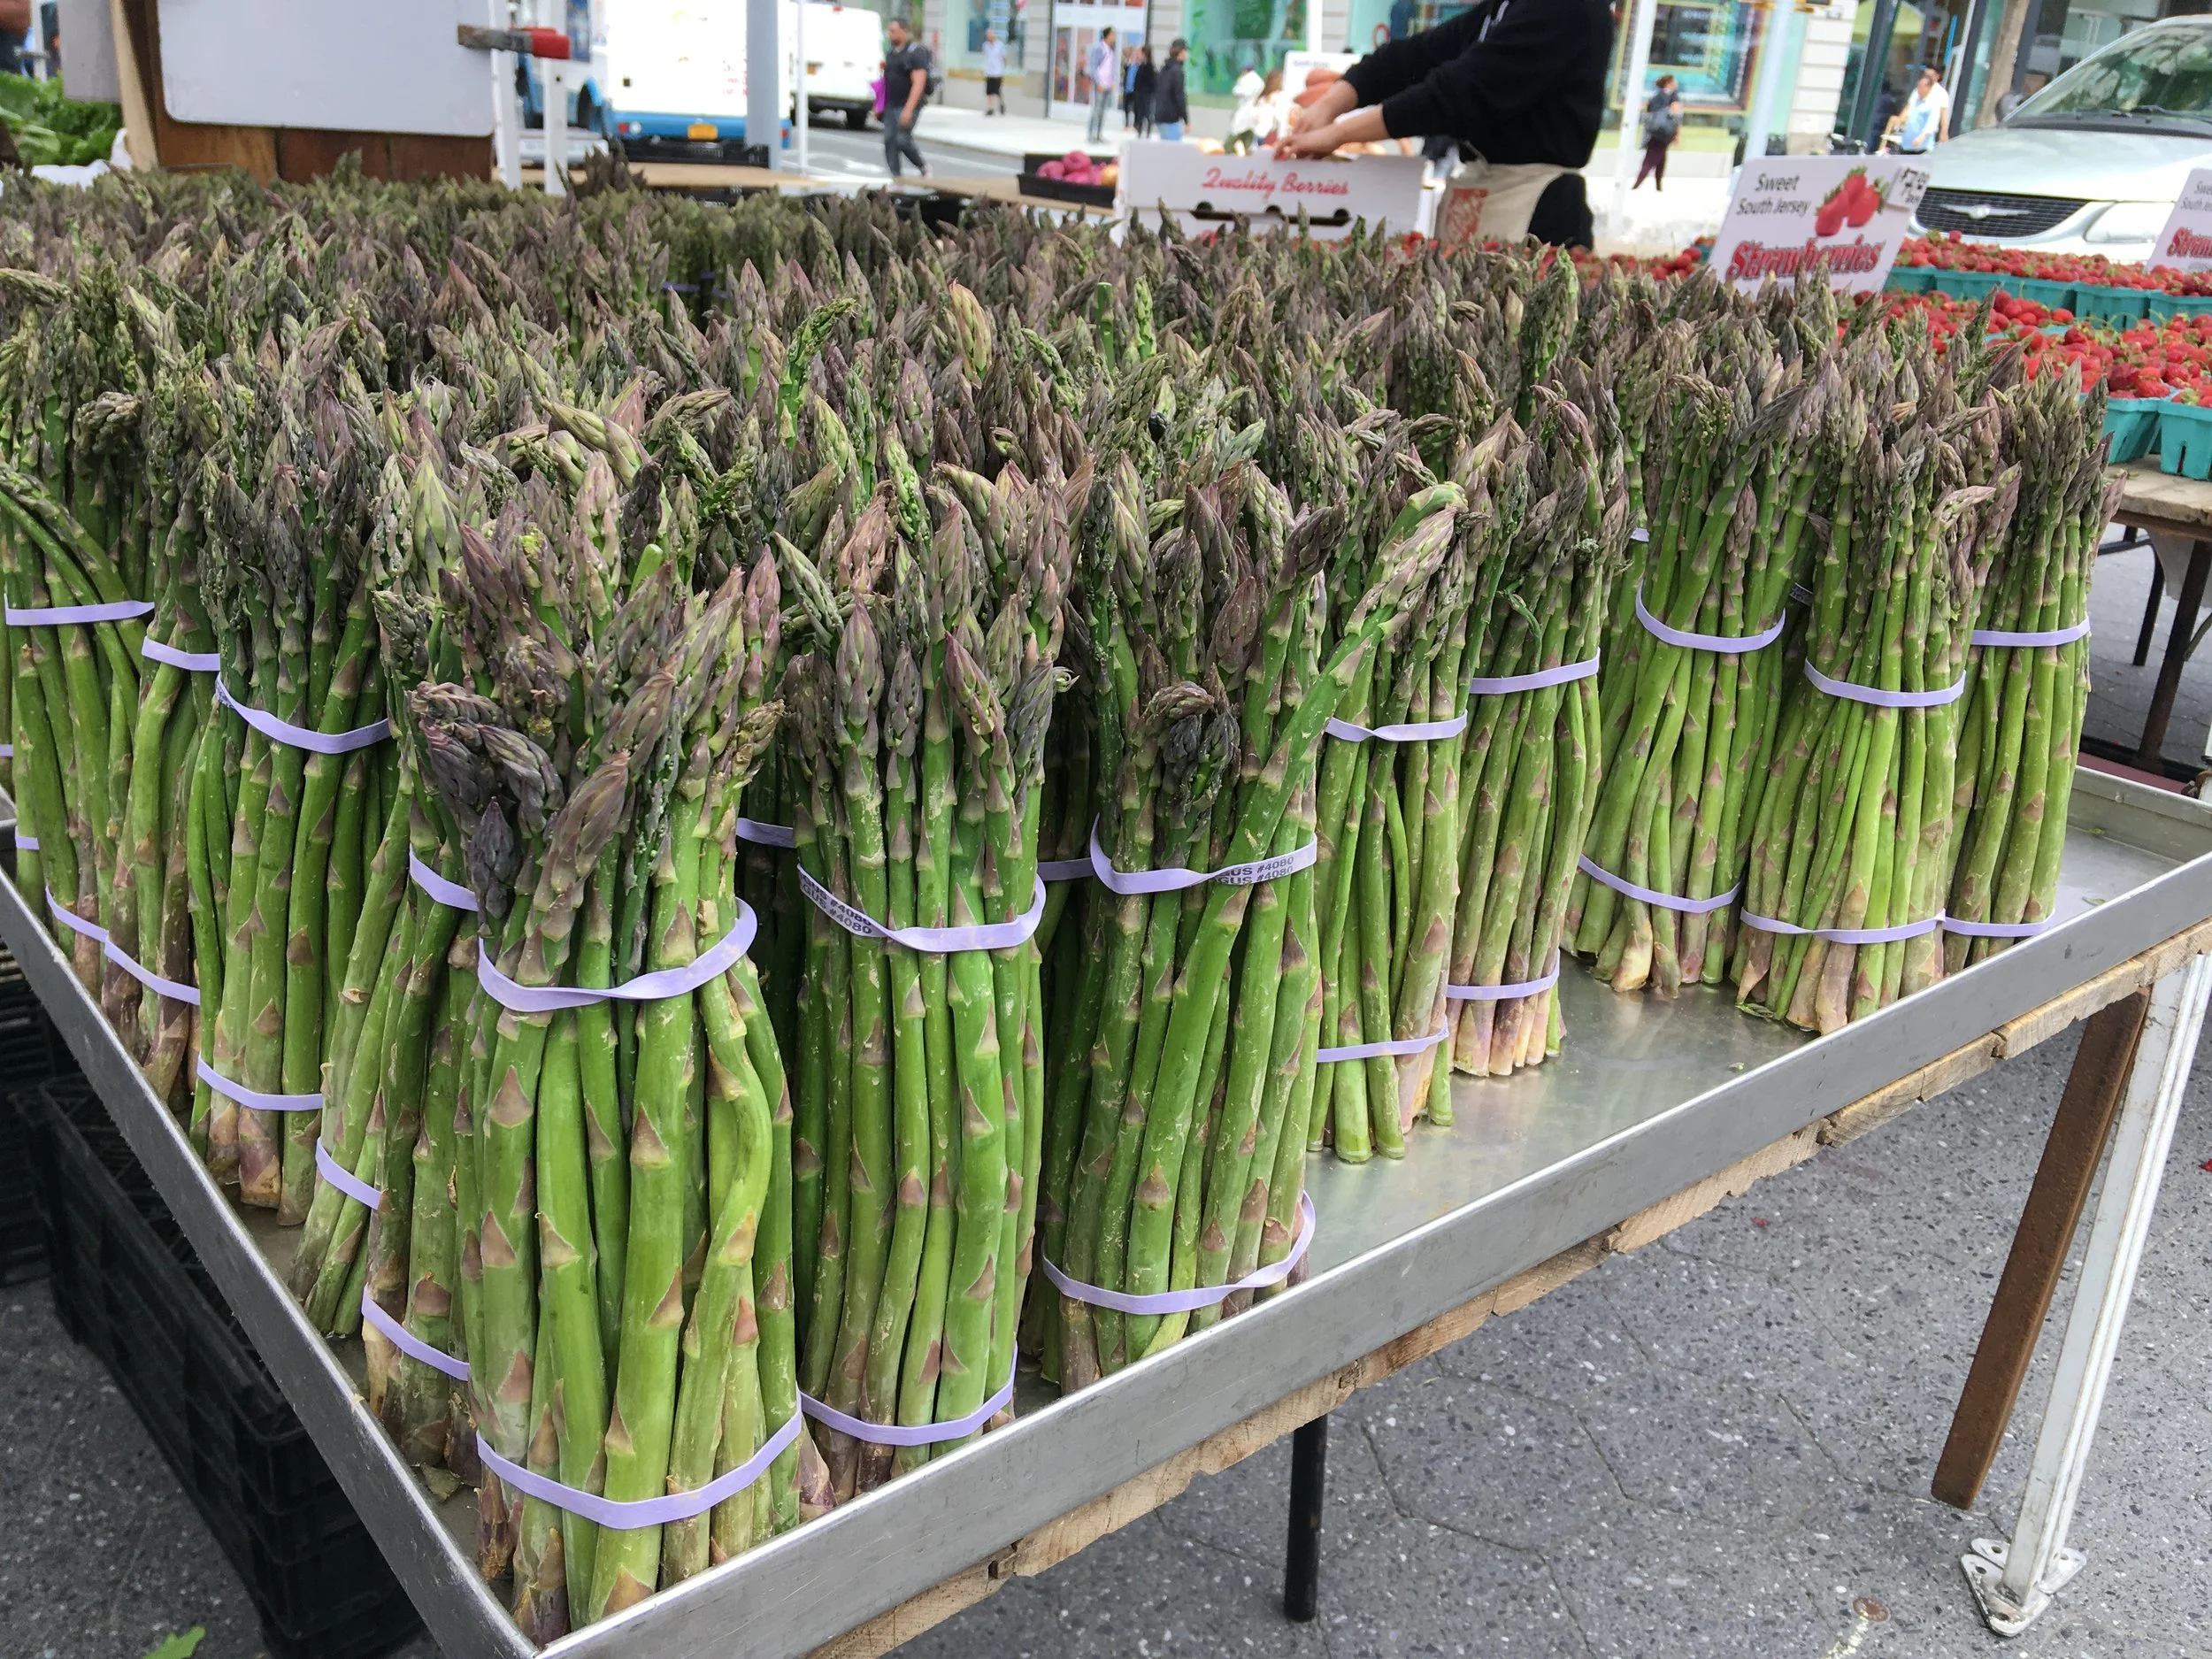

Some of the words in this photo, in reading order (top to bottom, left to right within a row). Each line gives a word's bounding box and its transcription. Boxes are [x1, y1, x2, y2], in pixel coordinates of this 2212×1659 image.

[1202, 166, 1276, 199] Quality
[1281, 172, 1349, 196] Berries
[1755, 173, 1800, 191] Sweet
[1736, 196, 1772, 215] South
[1773, 196, 1811, 218] Jersey
[1725, 234, 1886, 280] Strawberries
[1257, 856, 1294, 873] #4080
[1257, 867, 1293, 882] #4080
[830, 909, 872, 933] #4080
